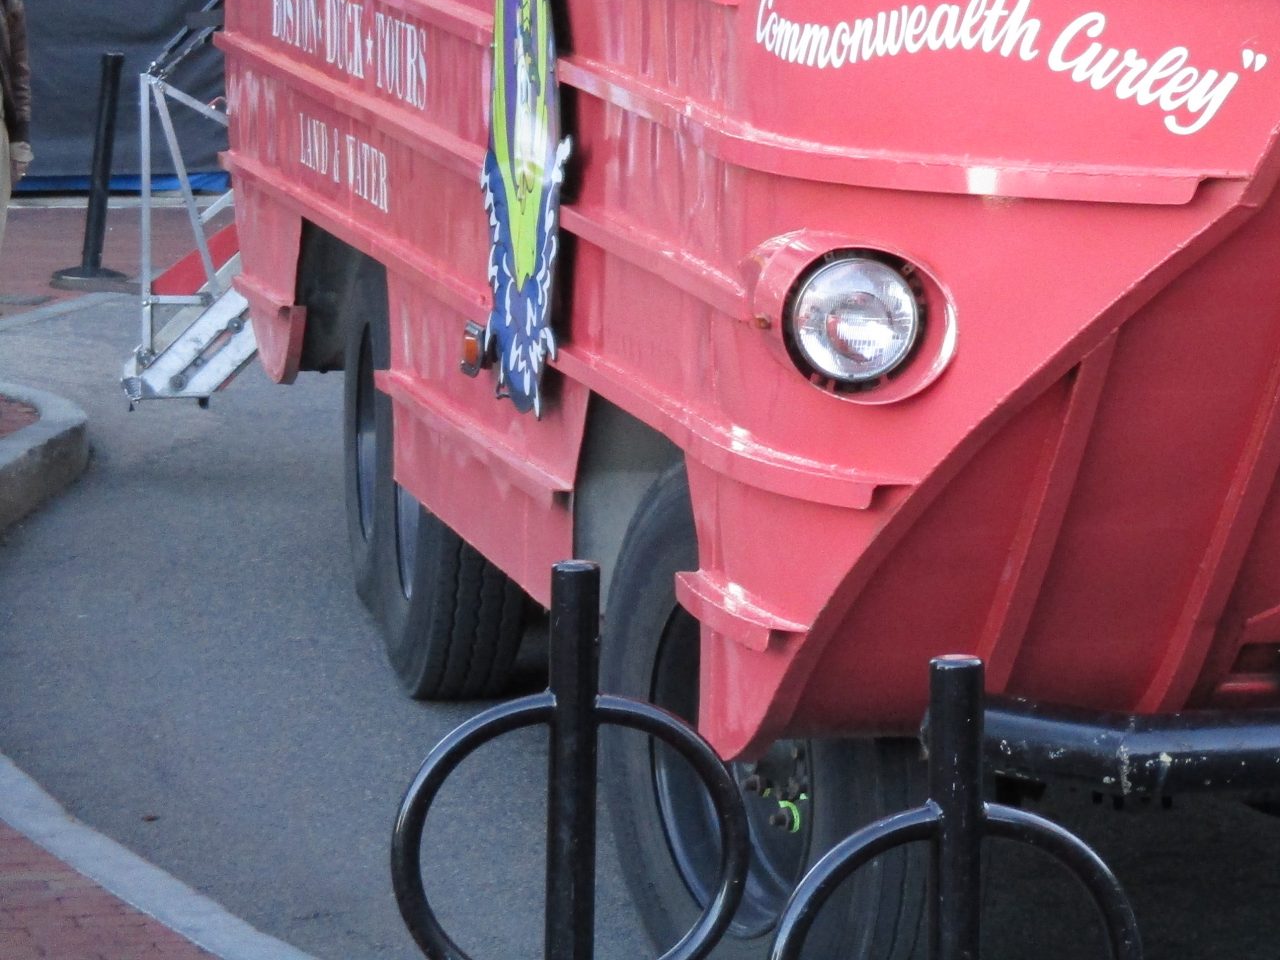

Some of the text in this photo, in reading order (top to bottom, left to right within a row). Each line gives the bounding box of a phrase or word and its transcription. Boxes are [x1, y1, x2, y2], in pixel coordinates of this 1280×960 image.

[375, 12, 428, 111] TOURS
[299, 113, 389, 213] LAND & WATER
